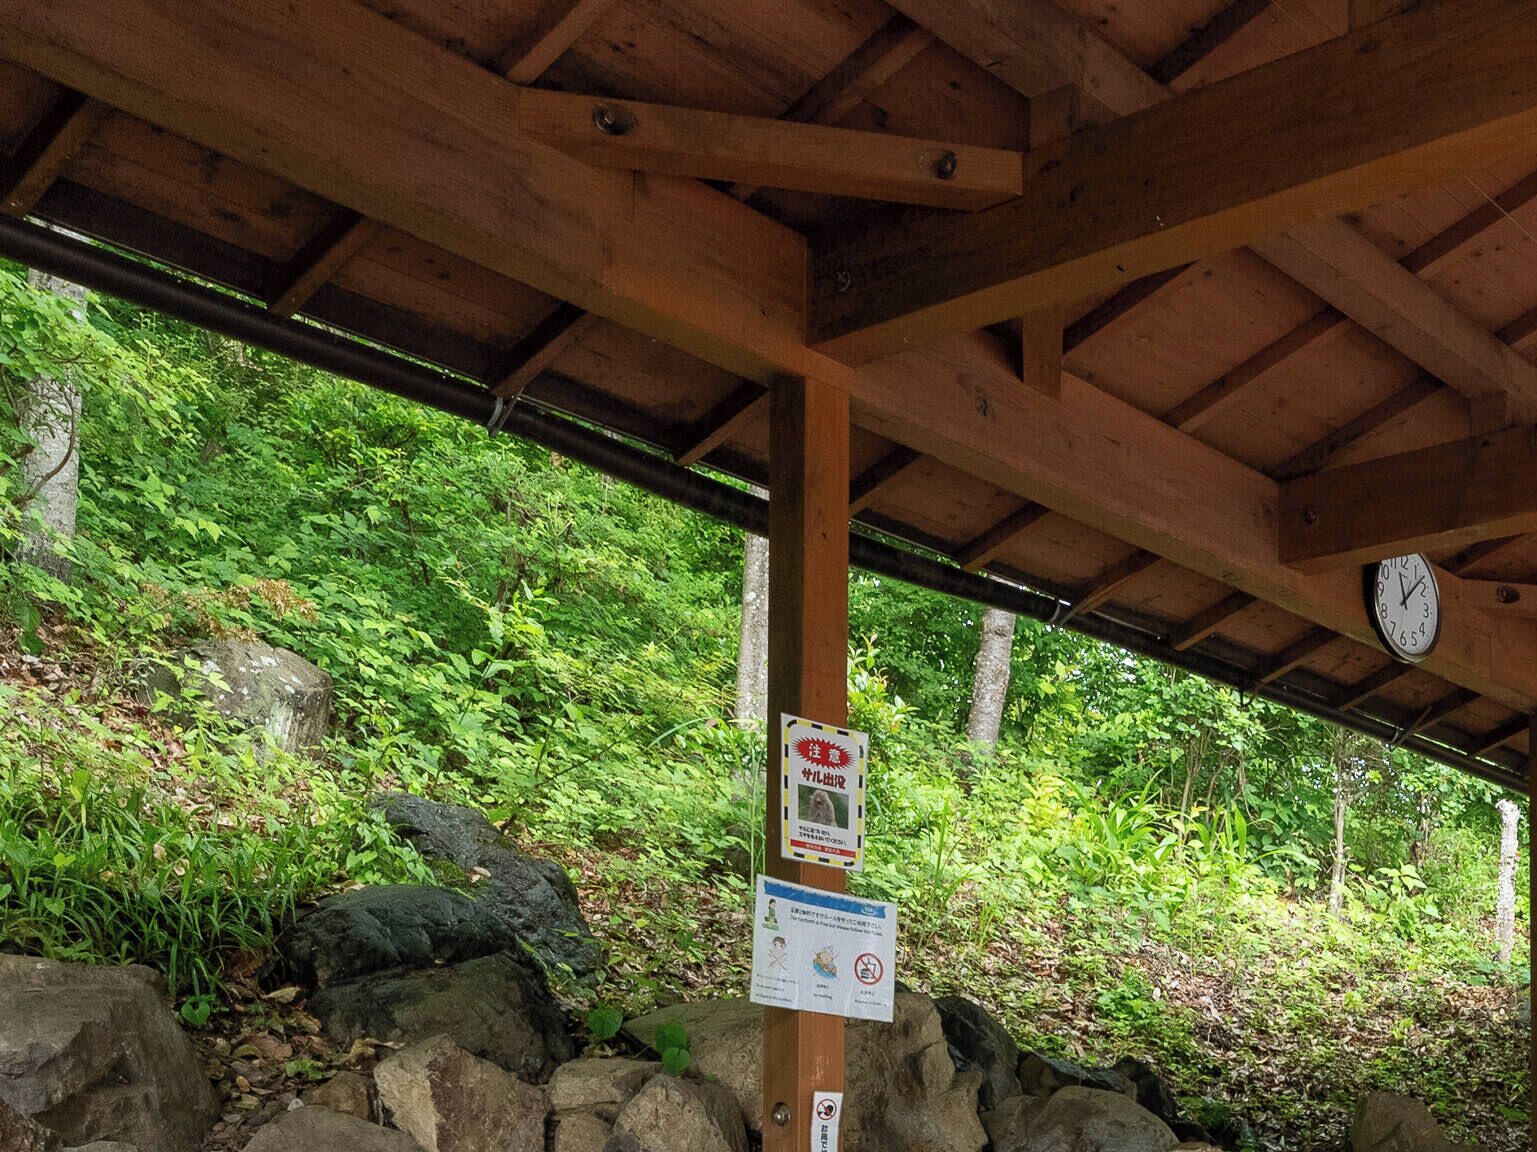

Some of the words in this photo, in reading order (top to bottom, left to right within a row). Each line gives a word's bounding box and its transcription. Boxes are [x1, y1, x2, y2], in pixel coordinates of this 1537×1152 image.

[1380, 562, 1390, 580] 10
[1401, 556, 1408, 570] 12
[1377, 581, 1385, 597] 9
[1420, 581, 1426, 598] 2
[1381, 603, 1388, 619] 8
[1423, 603, 1429, 618] 3
[1390, 621, 1396, 638] 7
[1419, 622, 1426, 637] 4
[1400, 631, 1407, 647] 6
[1411, 631, 1417, 647] 5
[809, 743, 841, 764] 注意
[801, 767, 846, 790] サル出没
